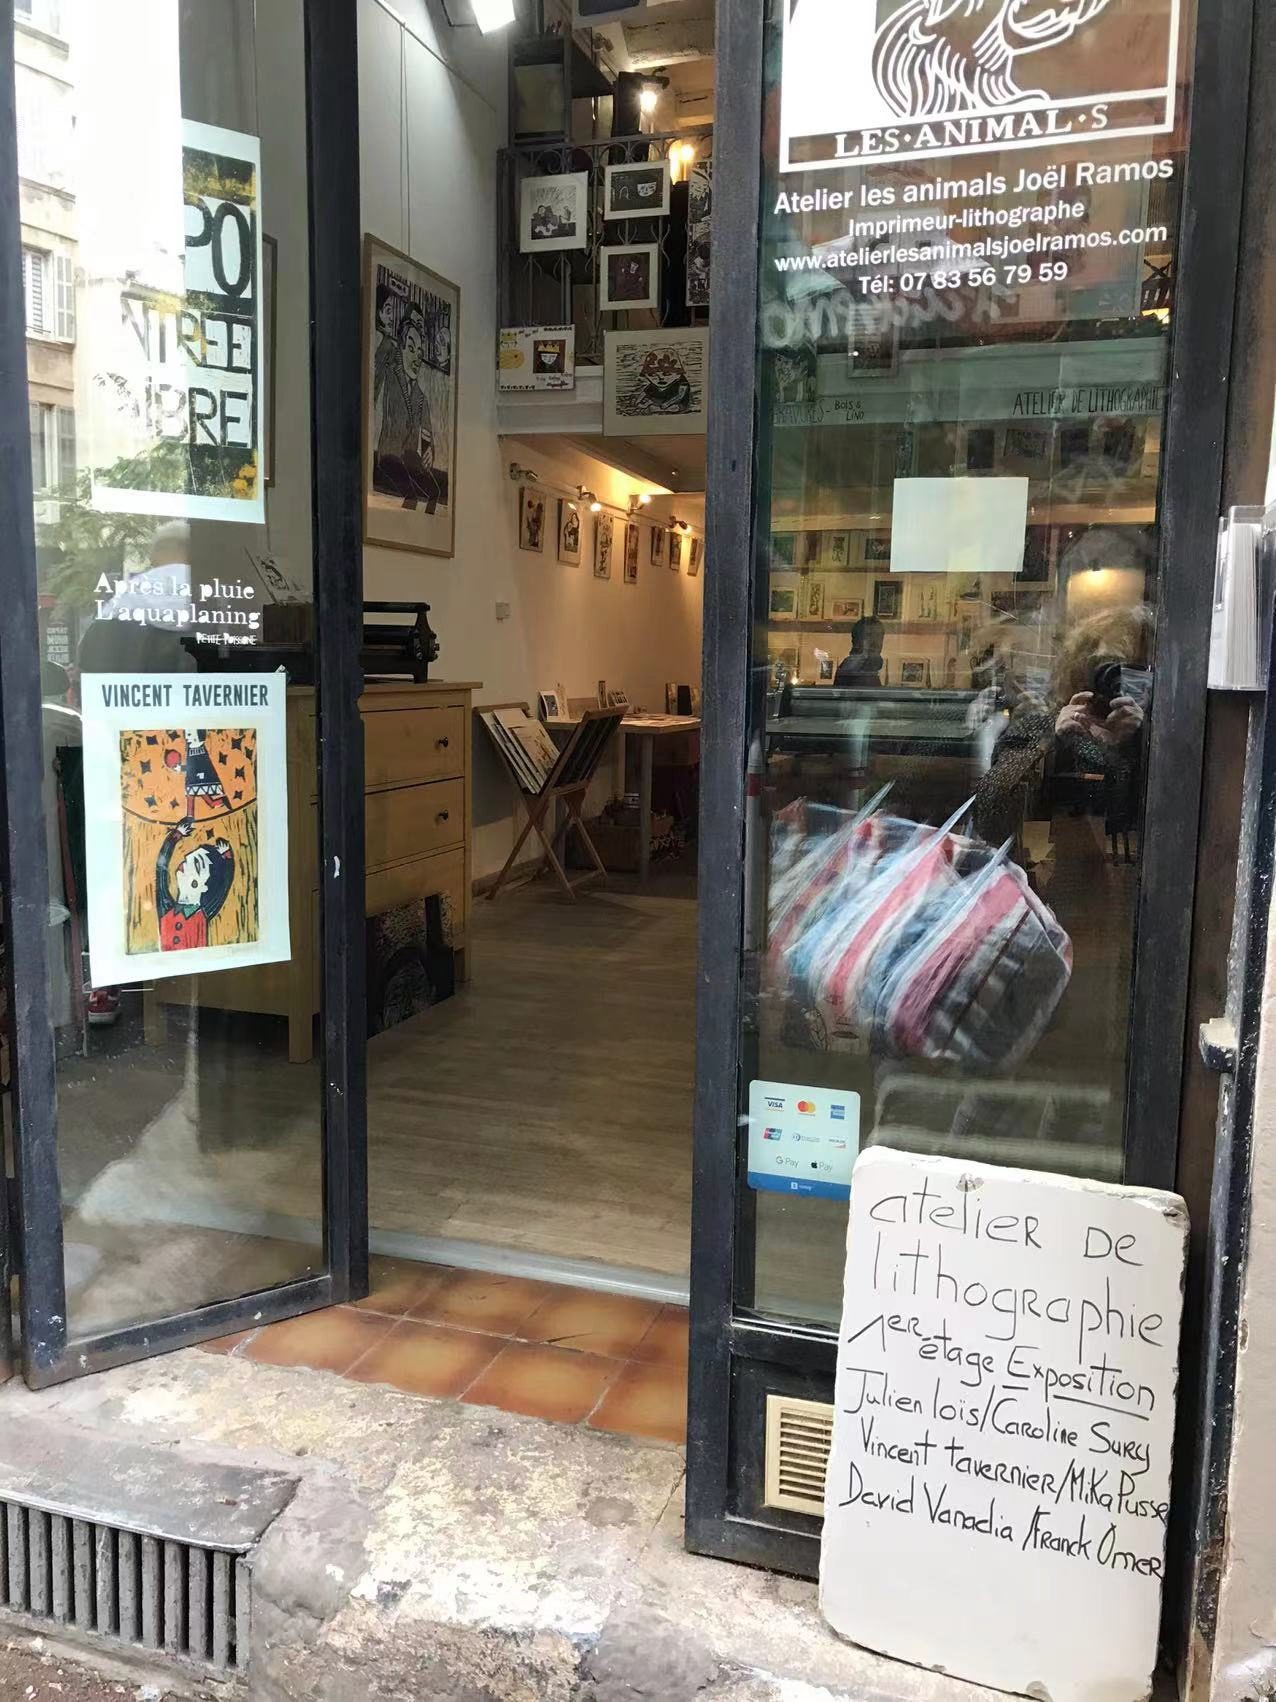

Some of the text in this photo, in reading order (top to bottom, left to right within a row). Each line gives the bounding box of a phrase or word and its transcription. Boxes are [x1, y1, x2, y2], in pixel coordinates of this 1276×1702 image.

[774, 159, 1174, 214] Atelier les animals Joël Ramos
[849, 201, 1085, 239] Imprimeur-lithographe
[184, 198, 253, 296] PO
[775, 226, 1168, 272] www.atelierlesanimalsjoelramos.com
[860, 261, 1068, 295] Tél: 07 83 56 79 59
[144, 376, 249, 449] IBRE
[1013, 389, 1066, 415] ATELIER
[1071, 389, 1086, 413] DE
[94, 572, 255, 601] Après la pluie
[94, 599, 260, 630] L'aquaplaning
[101, 683, 269, 708] VINCENT TAVERNIER
[767, 1100, 783, 1109] VISA
[785, 1157, 799, 1169] Pay
[843, 1367, 922, 1414] Julien
[1007, 1345, 1155, 1412] Exposition
[861, 1415, 938, 1467] Vincent
[838, 1461, 915, 1514] David
[923, 1482, 1014, 1542] Vanadia
